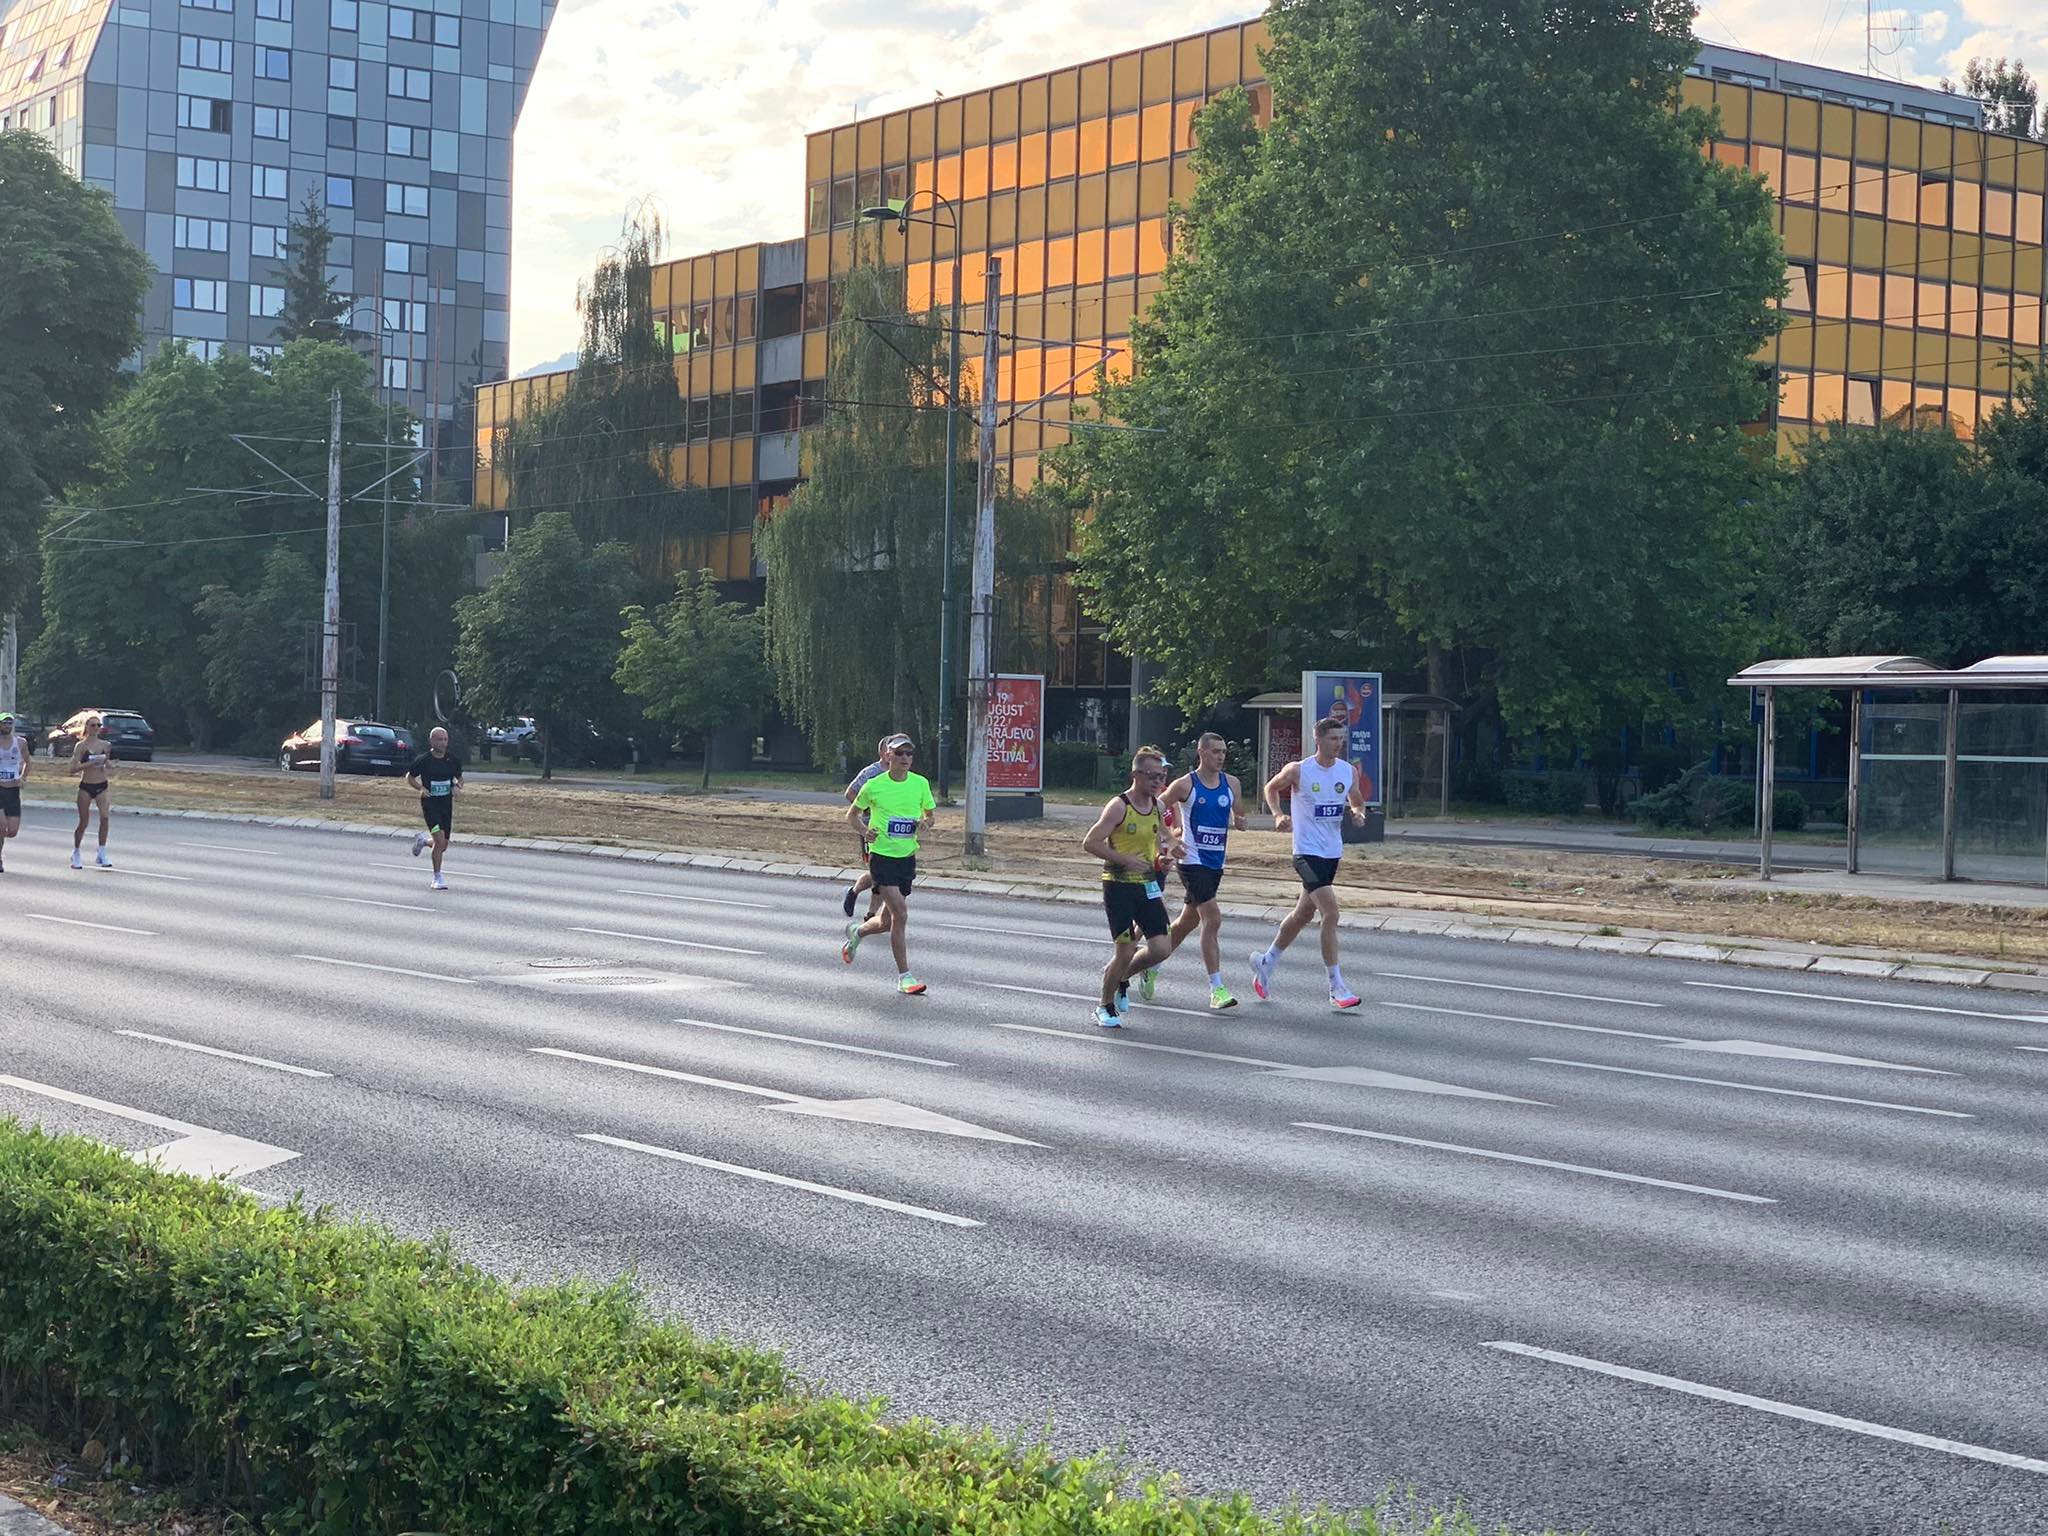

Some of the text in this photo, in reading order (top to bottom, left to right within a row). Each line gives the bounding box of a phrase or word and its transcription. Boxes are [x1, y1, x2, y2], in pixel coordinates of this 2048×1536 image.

[988, 704, 1025, 716] UGUST
[986, 727, 1034, 740] ARAJEVO
[986, 750, 1029, 763] ESTIVAL
[1322, 806, 1337, 816] 157
[894, 823, 912, 833] 080
[1202, 834, 1220, 844] 036
